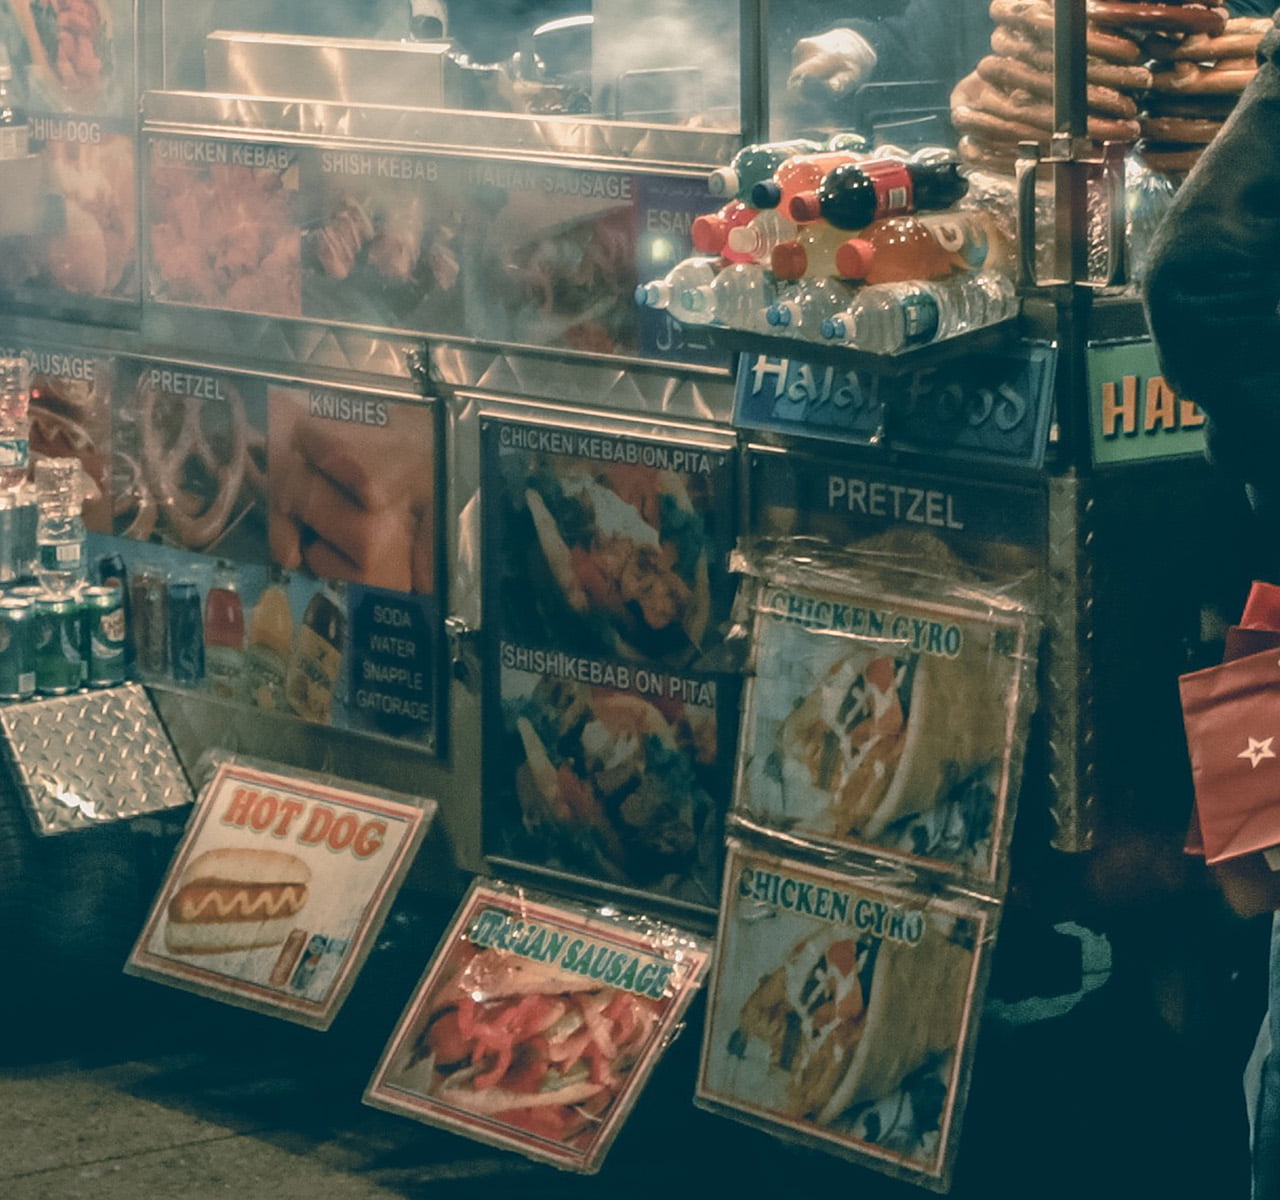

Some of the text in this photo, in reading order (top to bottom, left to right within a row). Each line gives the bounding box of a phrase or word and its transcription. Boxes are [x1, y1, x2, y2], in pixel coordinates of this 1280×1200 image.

[65, 120, 101, 144] DOG
[157, 139, 290, 170] CHICKEN KEBAB
[320, 152, 439, 182] SHISH KEBAB
[542, 174, 633, 199] SAUSAGE
[150, 370, 225, 401] PRETZEL
[310, 394, 388, 427] KNISHES
[499, 425, 712, 476] CHICKEN KEBAB ON PITA
[827, 476, 966, 531] PRETZEL
[373, 604, 412, 628] SODA
[768, 592, 963, 659] CHICKEN GYRO
[370, 634, 416, 658] WATER
[362, 661, 423, 690] SNAPPLE
[502, 642, 713, 707] SHISH KEBAB ON PITA
[355, 689, 431, 722] GATORADE
[222, 788, 389, 860] HOT DOG
[739, 866, 926, 944] CHICKEN GYRO
[470, 910, 675, 1002] ITALIAN SAUSAGE
